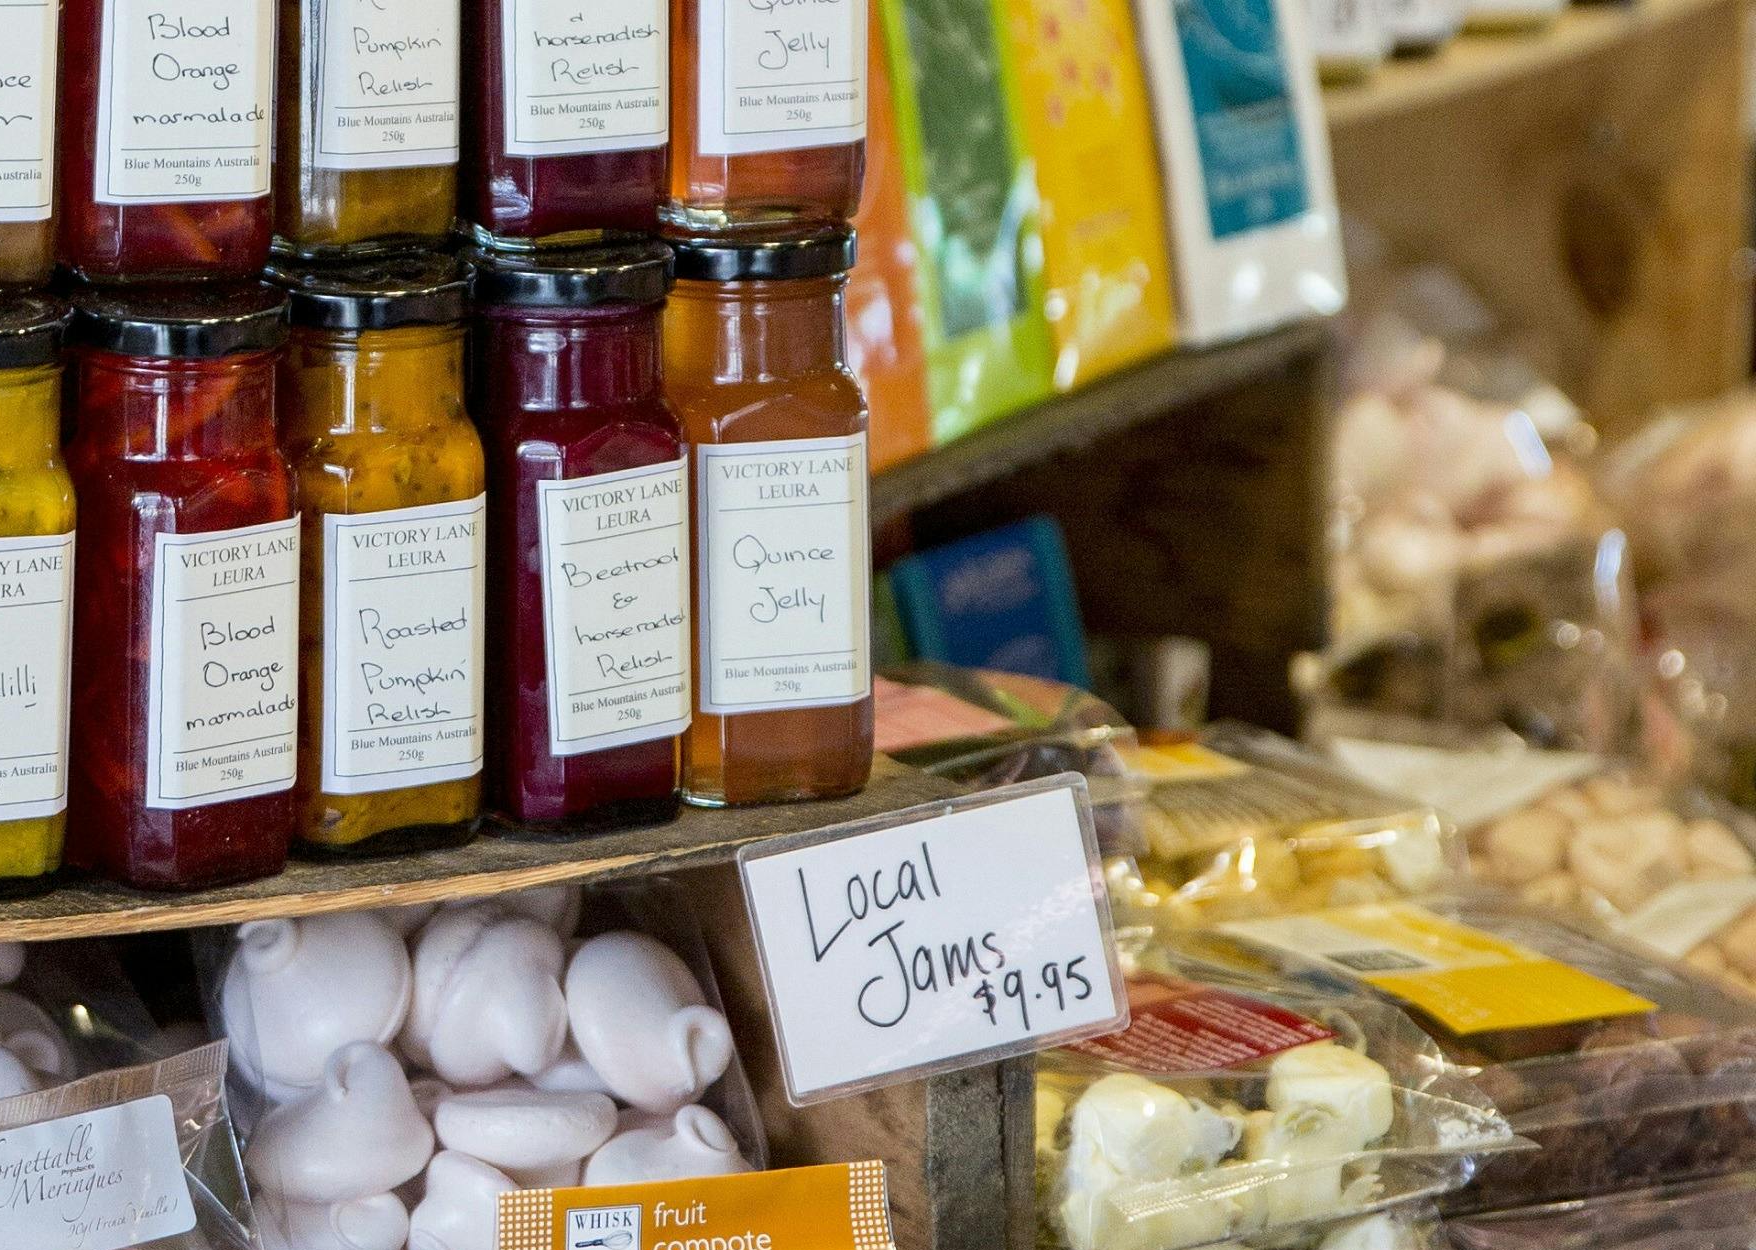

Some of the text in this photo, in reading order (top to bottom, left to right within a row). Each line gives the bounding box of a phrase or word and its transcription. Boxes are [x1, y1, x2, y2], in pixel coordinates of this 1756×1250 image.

[148, 13, 230, 40] Blood
[534, 24, 660, 47] horseradish
[353, 27, 441, 60] Pumpkin
[758, 30, 830, 71] Jelly
[152, 53, 240, 90] Orange
[551, 58, 640, 85] Relish
[359, 72, 433, 96] Relish
[133, 103, 265, 124] marmalade
[580, 118, 605, 130] 250g
[786, 110, 812, 122] 250g
[382, 131, 405, 143] 250g
[124, 155, 260, 170] Blue Mountains Australia
[175, 174, 202, 187] 250g
[722, 456, 853, 480] VICTORY LANE
[561, 478, 683, 513] VICTORY LANE
[759, 483, 820, 500] LEURA
[597, 508, 652, 531] LEURA
[353, 521, 478, 549] VICTORY LANE
[16, 555, 63, 574] LANE
[180, 536, 297, 569] VICTORY LANE
[388, 550, 446, 569] LEURA
[733, 534, 836, 575] Quince
[213, 566, 265, 587] LEURA
[561, 547, 679, 588] Beetroot
[750, 587, 825, 624] Jelly
[201, 616, 275, 651] Blood
[359, 607, 468, 650] Roasted
[203, 661, 284, 692] Orange
[361, 659, 466, 695] Pumpkin
[597, 651, 673, 680] Relish
[774, 680, 801, 693] 250g
[367, 702, 451, 725] Relish
[618, 707, 643, 722] 250g
[399, 749, 425, 762] 250g
[11, 763, 58, 778] Australia
[220, 768, 244, 781] 250g
[799, 840, 941, 962] Local
[858, 920, 1006, 1028] Jams
[973, 955, 1092, 1031] $9.95
[575, 1211, 633, 1230] WHISK
[653, 1199, 708, 1228] fruit
